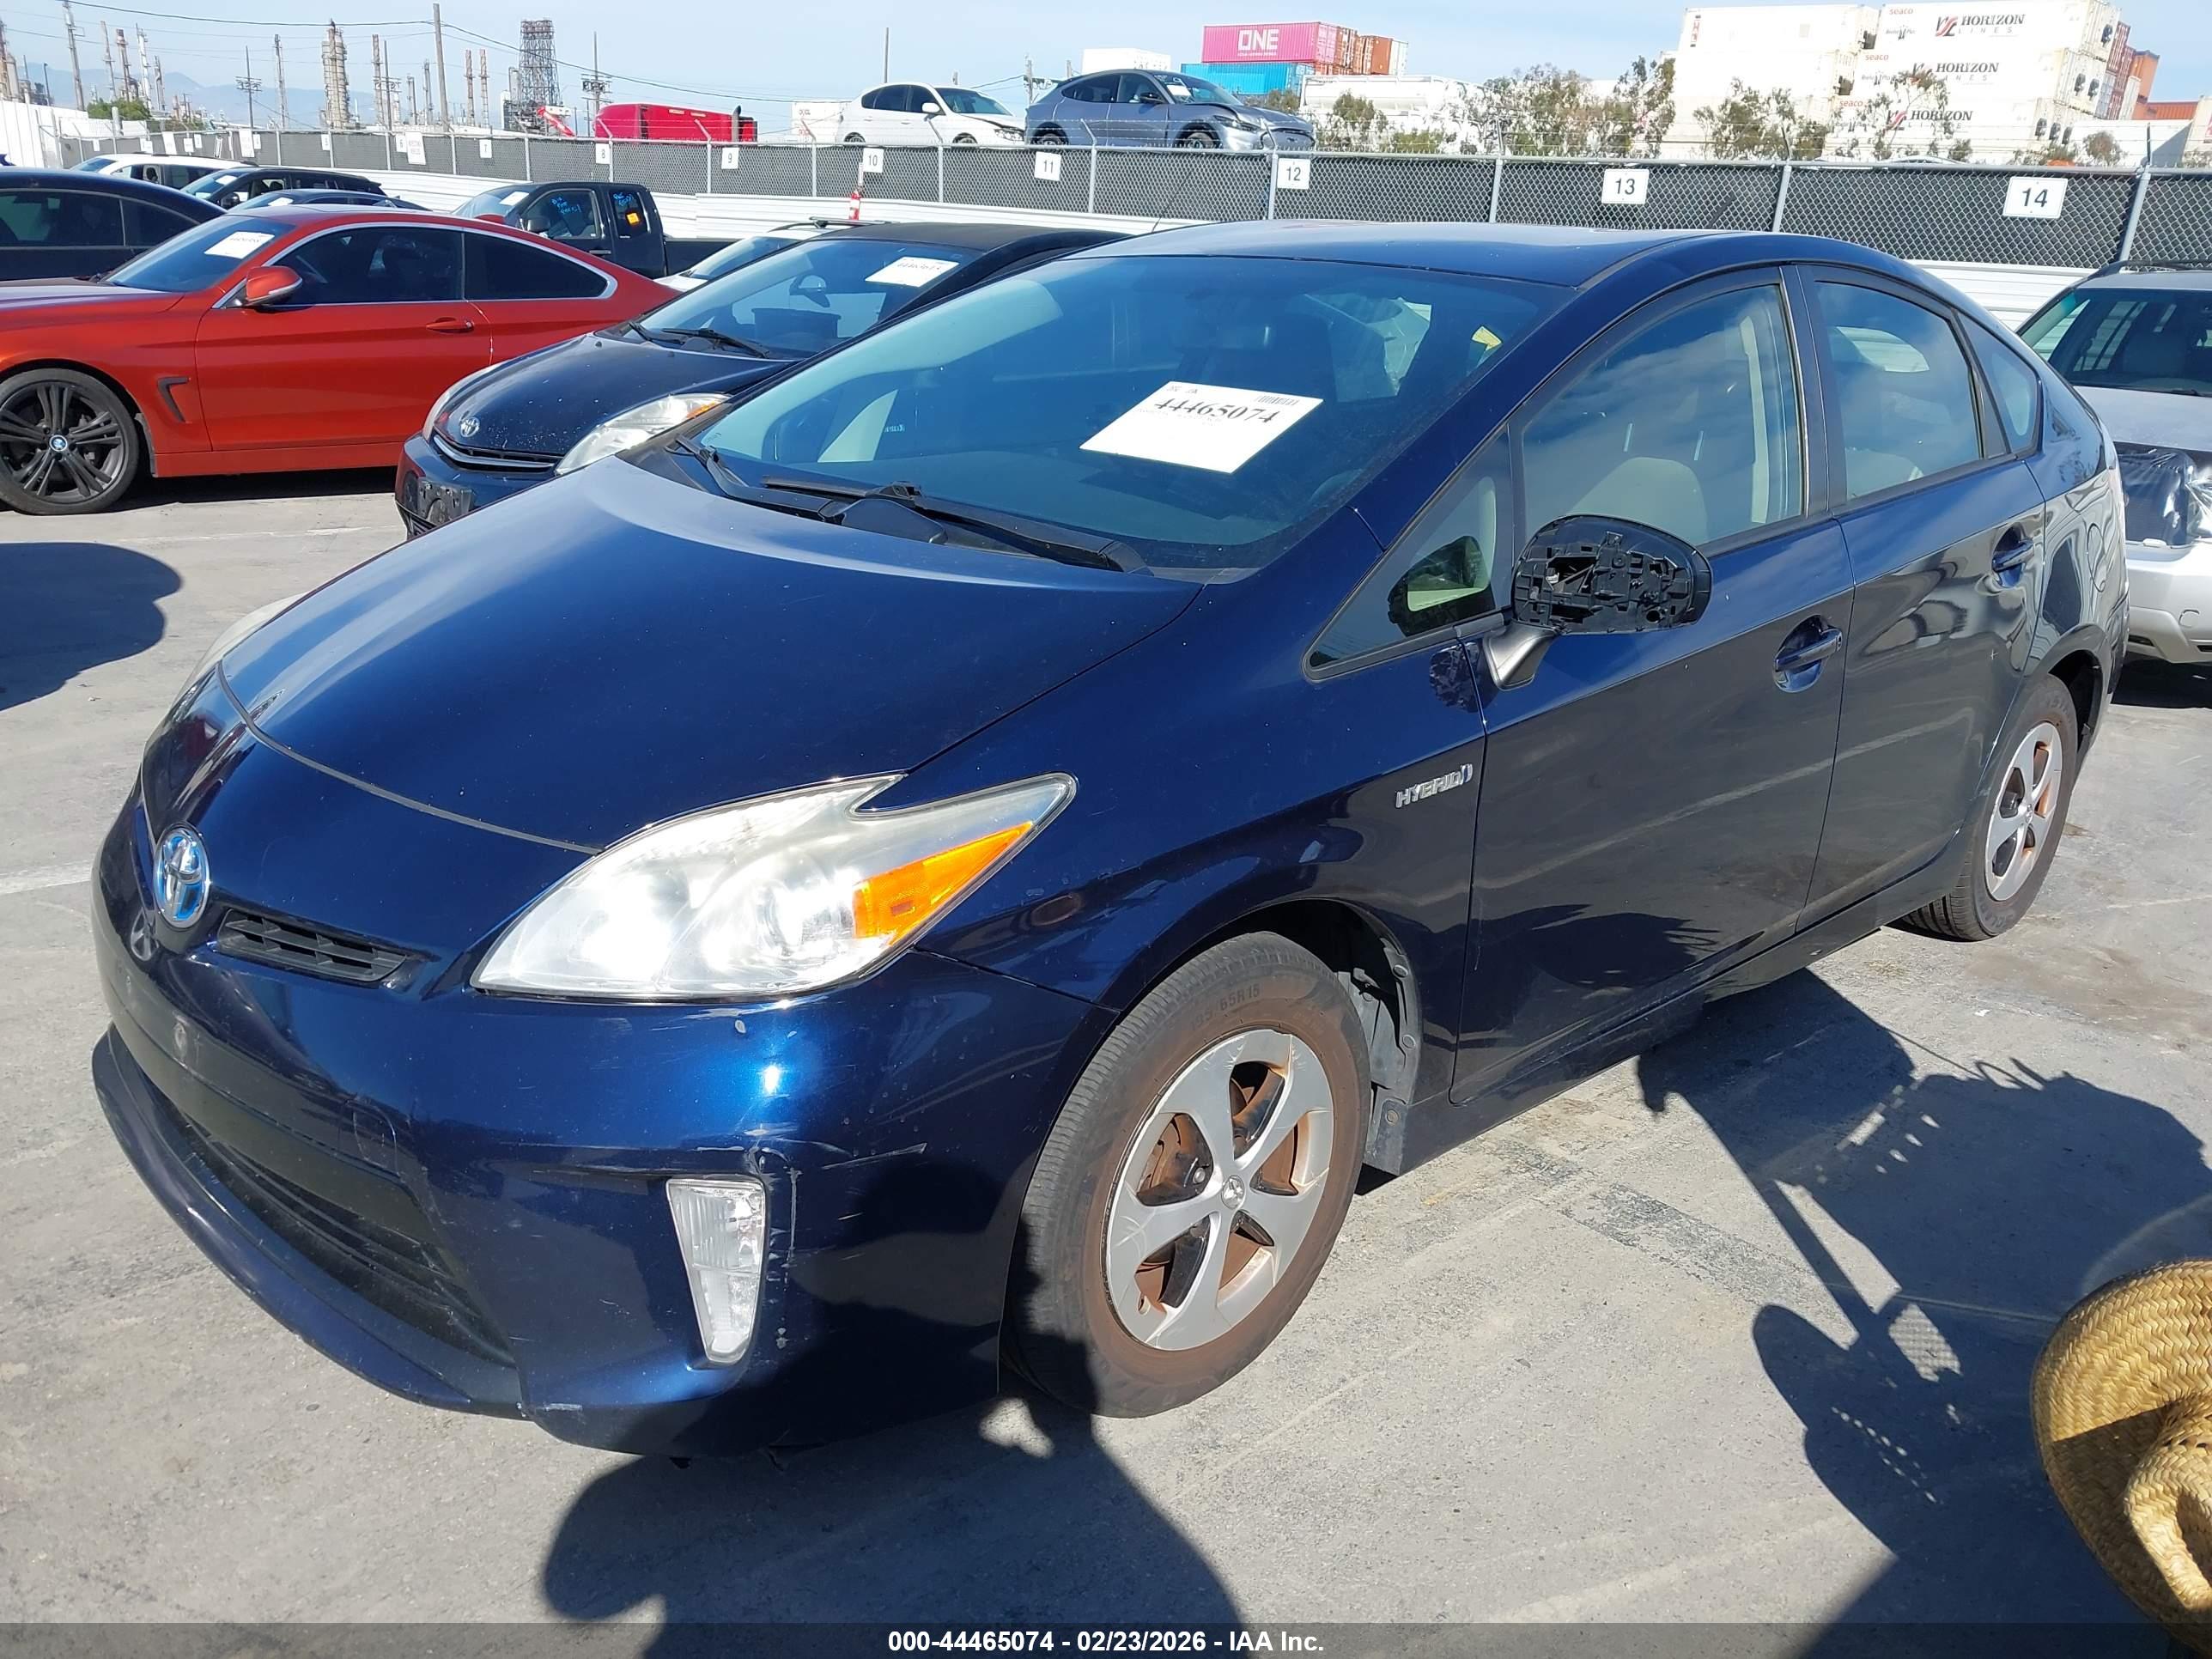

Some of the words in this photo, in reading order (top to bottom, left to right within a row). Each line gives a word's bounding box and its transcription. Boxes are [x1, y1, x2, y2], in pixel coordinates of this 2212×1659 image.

[1961, 15, 2026, 26] HORIZON
[1237, 28, 1279, 51] ONE
[1936, 63, 1999, 73] HORIZON
[1911, 110, 1973, 121] HORIZON
[601, 149, 606, 159] 8
[727, 153, 733, 164] 9
[868, 155, 878, 167] 10
[1043, 159, 1054, 173] 11
[1286, 167, 1301, 181] 12
[1615, 178, 1635, 195] 13
[2022, 187, 2048, 207] 14
[1154, 398, 1280, 423] 44465074
[1395, 769, 1465, 808] HYBRID
